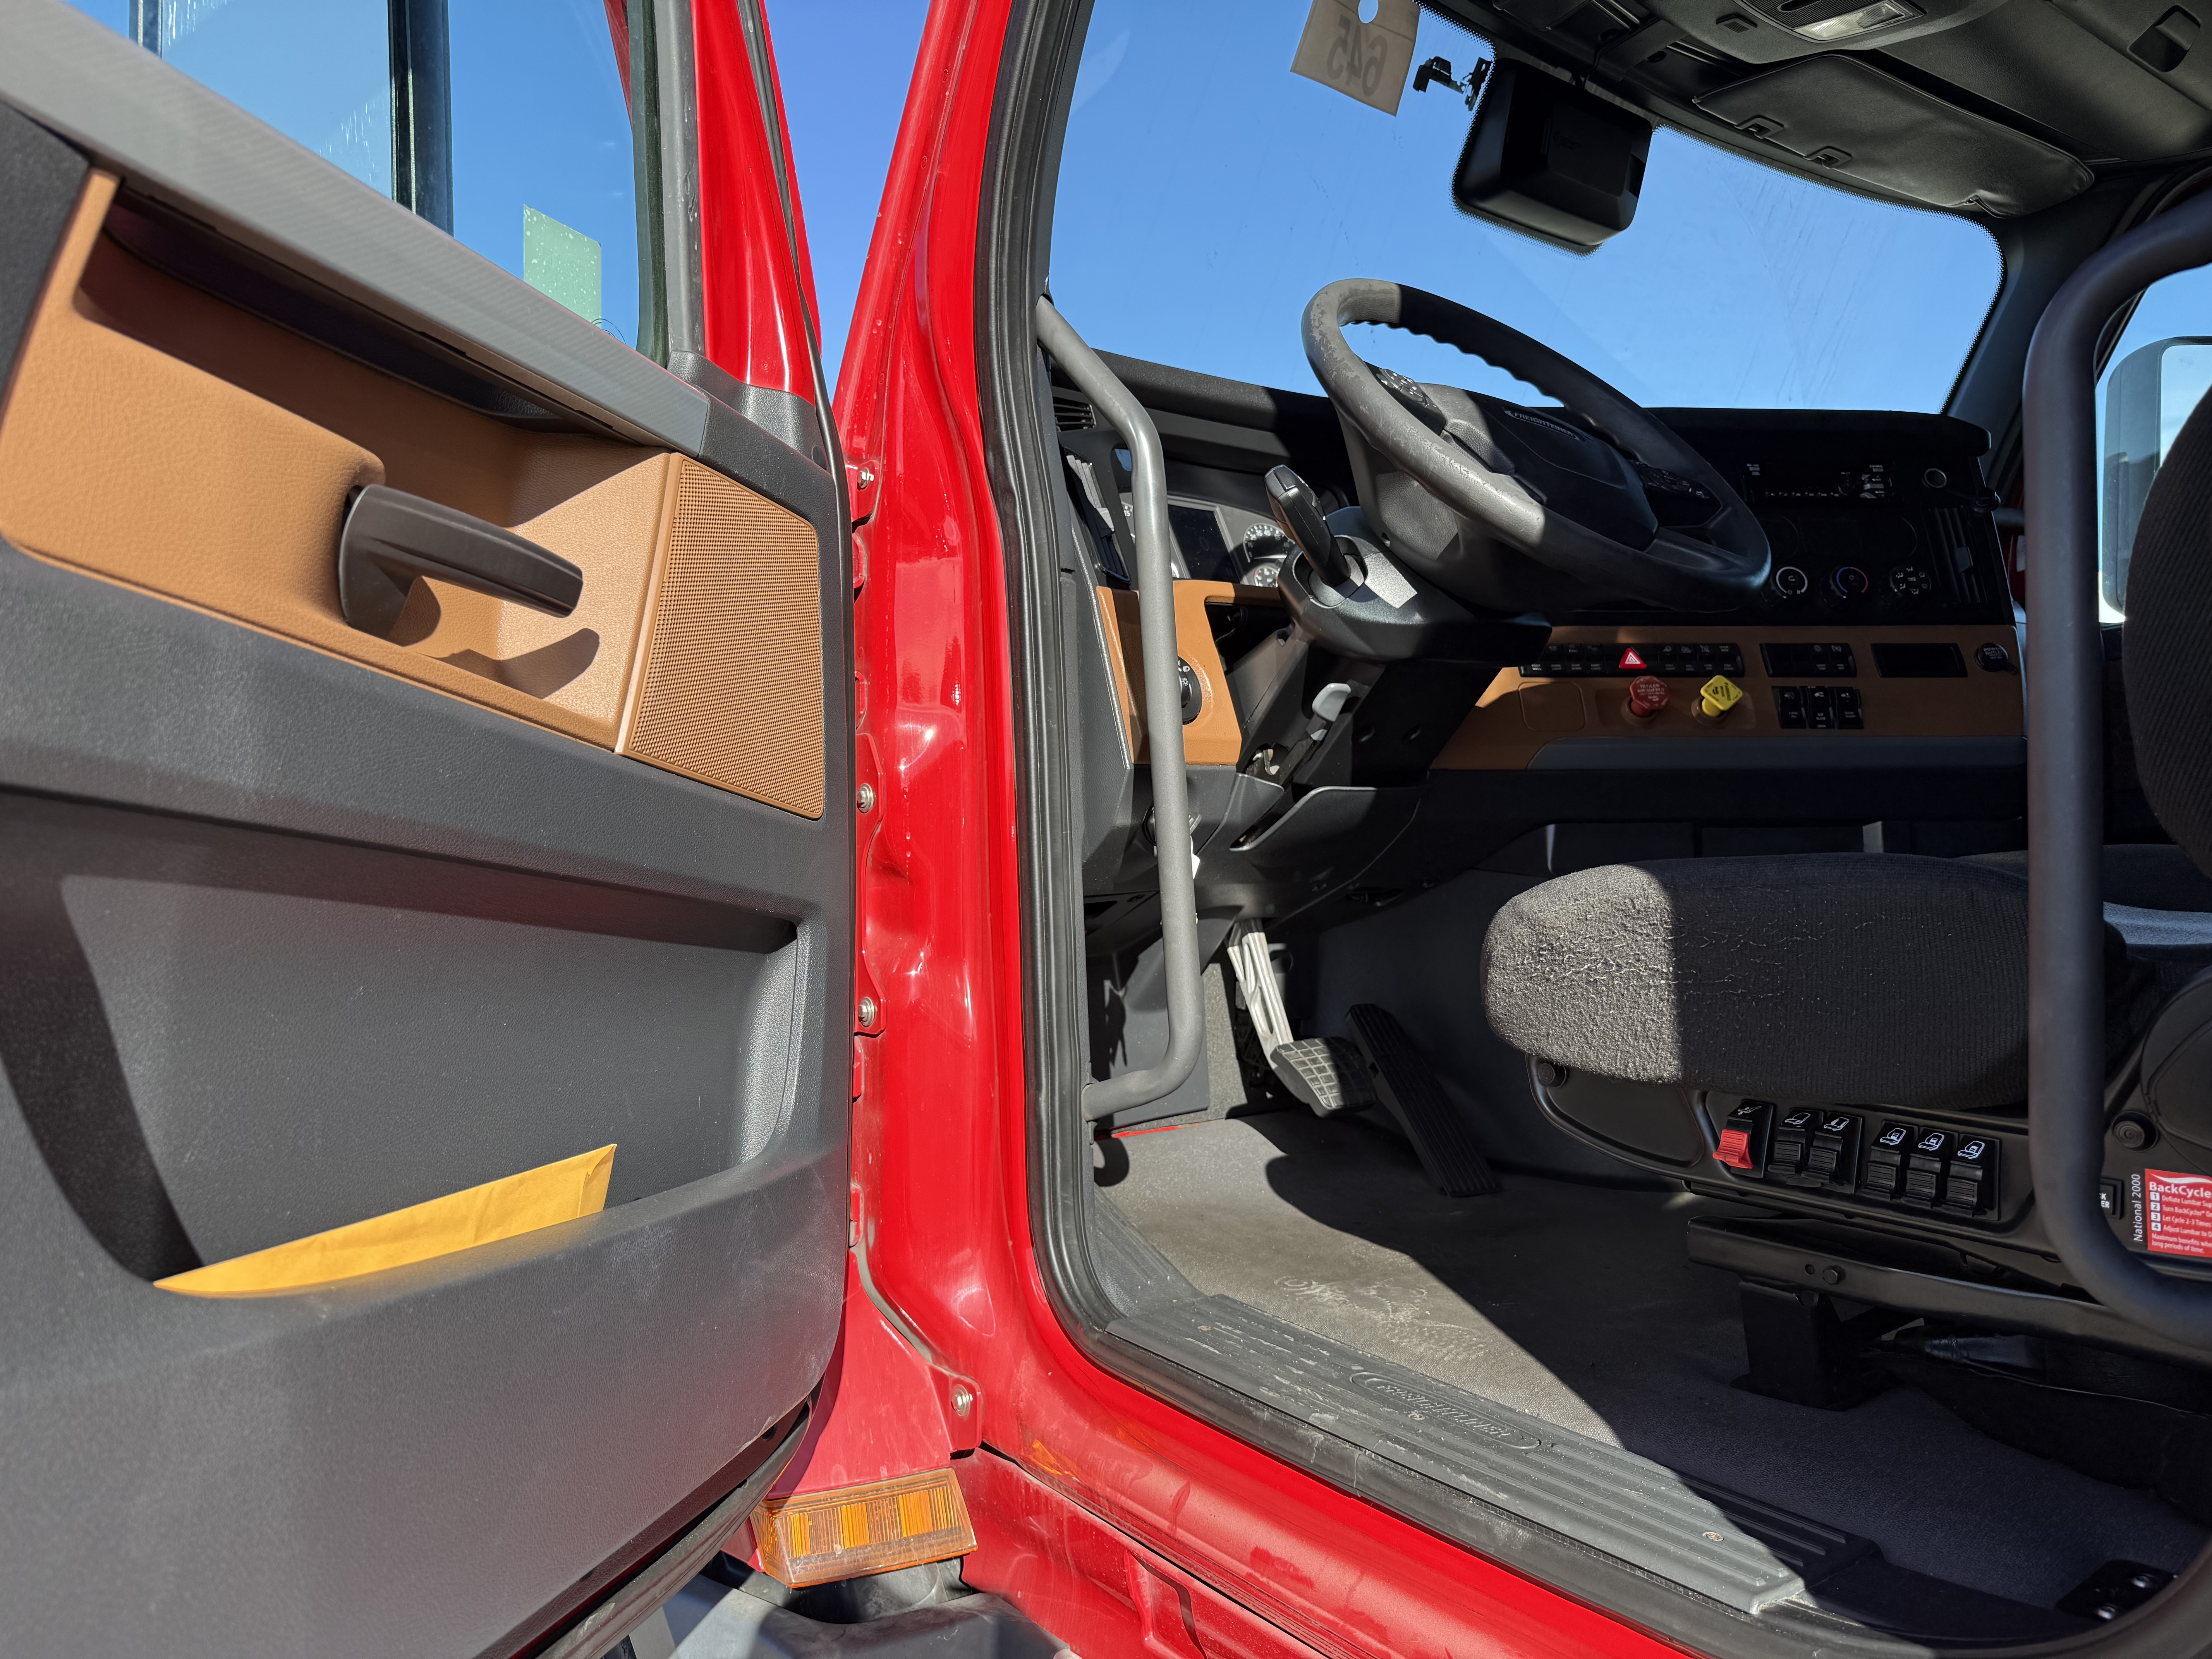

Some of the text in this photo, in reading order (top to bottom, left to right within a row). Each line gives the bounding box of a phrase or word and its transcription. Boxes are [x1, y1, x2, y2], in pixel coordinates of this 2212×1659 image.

[1514, 412, 1575, 438] FREIGHTLINER
[2149, 1182, 2212, 1199] BackCycle
[2161, 1195, 2181, 1203] Deflate
[2181, 1197, 2202, 1206] Lumbar
[2131, 1174, 2143, 1242] National 2000
[2195, 1219, 2212, 1227] Times
[2163, 1224, 2180, 1233] Adjust
[2180, 1227, 2201, 1235] Lumbar
[2152, 1233, 2178, 1242] Maximum
[2178, 1237, 2200, 1246] benefits
[2152, 1239, 2164, 1249] long
[2164, 1242, 2184, 1250] periods
